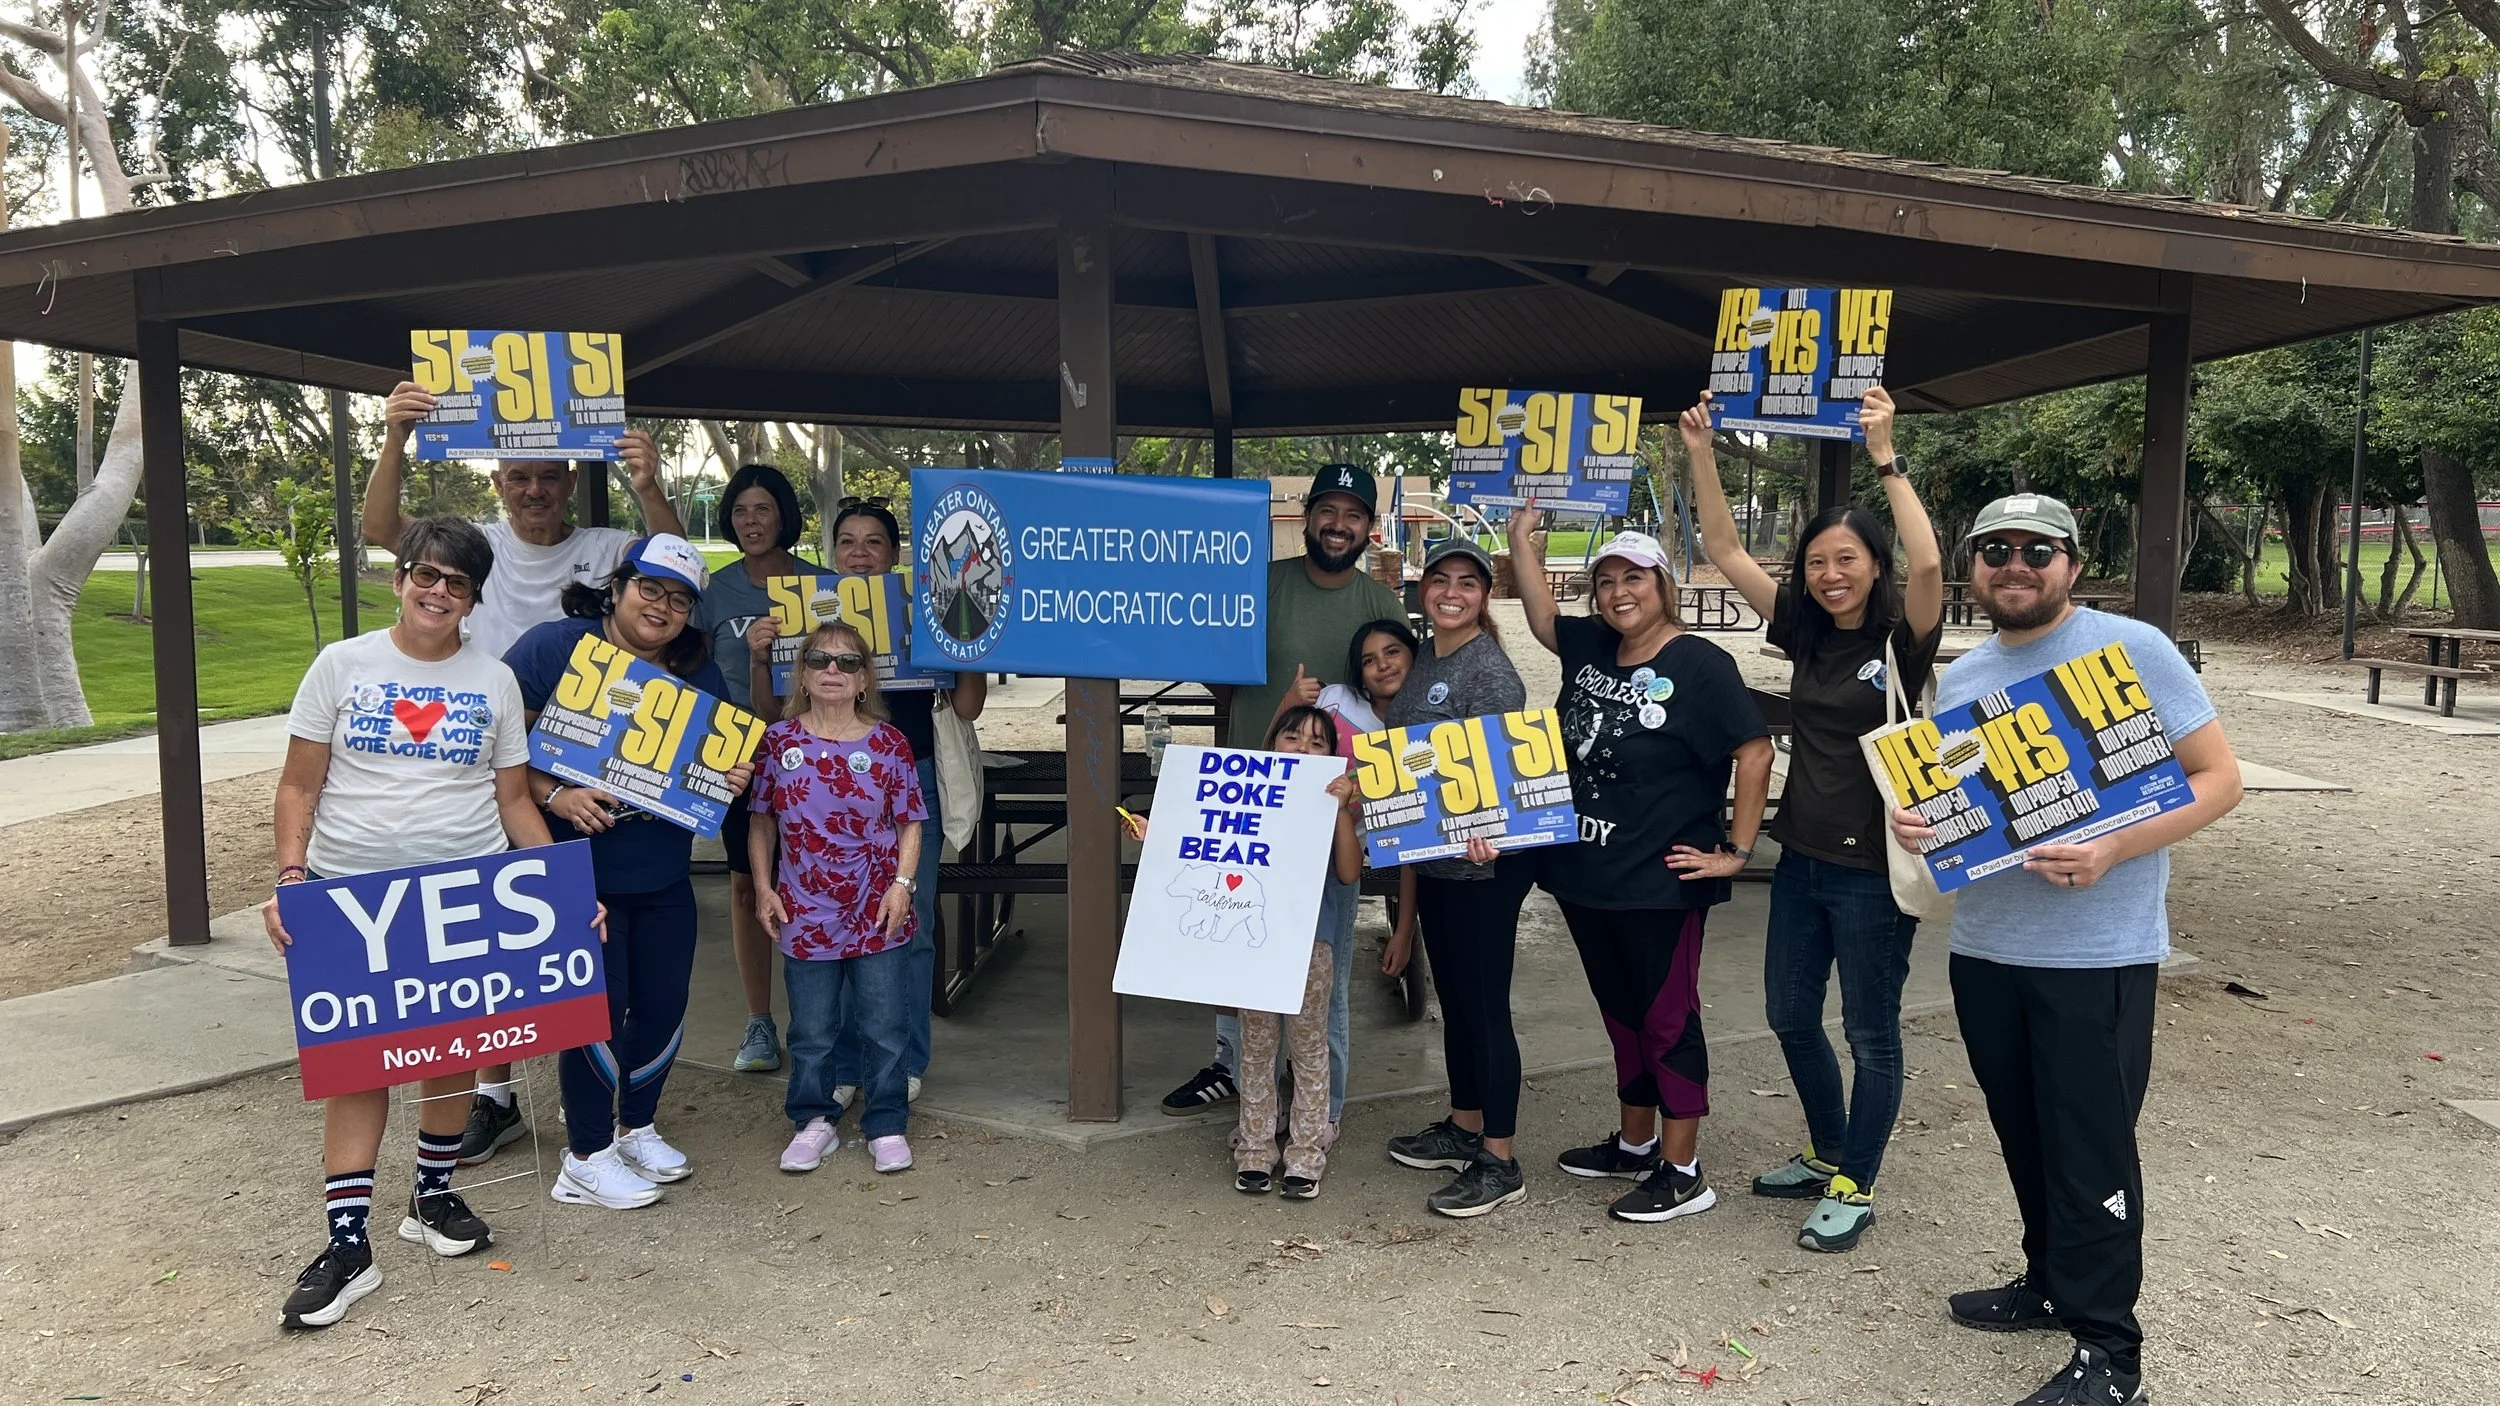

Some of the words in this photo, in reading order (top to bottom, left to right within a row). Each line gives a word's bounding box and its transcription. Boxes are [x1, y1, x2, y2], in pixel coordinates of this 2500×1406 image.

[1788, 289, 1807, 309] VOTE
[1714, 288, 1760, 351] YES
[1839, 289, 1893, 354] YES
[1769, 310, 1820, 373] YES
[1721, 352, 1739, 371] PROP
[1839, 357, 1850, 376] ON
[1852, 356, 1872, 376] PROP
[1769, 374, 1780, 393] ON
[1781, 374, 1800, 394] PROP
[1801, 375, 1812, 394] 50
[438, 407, 478, 421] NOVIEMBRE
[1761, 395, 1803, 416] NOVEMBER
[1803, 396, 1818, 415] 4TH
[424, 433, 436, 441] YES
[507, 419, 550, 435] PROPOSICIÓN
[521, 434, 558, 447] NOVIEMBRE
[1759, 422, 1769, 430] The
[1770, 423, 1797, 432] California
[1798, 425, 1831, 435] Democratic
[1832, 428, 1848, 437] Party
[582, 450, 600, 458] Party
[1338, 467, 1352, 487] LA
[1552, 501, 1586, 509] Democratic
[921, 492, 962, 564] GREATER
[967, 491, 1011, 568] ONTARIO
[1021, 526, 1132, 562] GREATER
[1140, 529, 1250, 565] ONTARIO
[1022, 590, 1182, 624] DEMOCRATIC
[1190, 593, 1255, 627] CLUB
[922, 593, 987, 658] DEMOCRATIC
[990, 594, 1009, 640] CLUB
[401, 686, 445, 702] VOTE
[448, 692, 487, 705] VOTE
[1575, 664, 1652, 710] CHILDLESS
[2053, 640, 2152, 731] YES
[1978, 688, 2015, 718] VOTE
[350, 715, 392, 735] VOTE
[539, 716, 550, 730] EL
[552, 720, 565, 735] DE
[561, 723, 602, 749] NOVIEMBRE
[554, 703, 602, 735] PROPOSICIÓN
[442, 728, 483, 746] VOTE
[538, 741, 551, 751] YES
[1968, 702, 2070, 793] YES
[2096, 727, 2123, 754] ON
[2114, 714, 2154, 746] PROP
[344, 734, 387, 753] VOTE
[390, 742, 436, 759] VOTE
[440, 748, 480, 765] VOTE
[2098, 736, 2172, 781] NOVEMBER
[611, 758, 622, 771] LA
[618, 758, 664, 787] PROPOSICIÓN
[660, 776, 673, 789] 50
[692, 764, 702, 776] LA
[1199, 752, 1299, 780] DON'T
[1876, 720, 1962, 808] YES
[553, 763, 564, 773] Ad
[563, 767, 581, 779] Paid
[579, 773, 589, 782] for
[587, 777, 598, 786] by
[597, 780, 611, 791] The
[611, 786, 643, 803] California
[641, 797, 680, 818] Democratic
[678, 813, 696, 826] Party
[605, 770, 616, 783] EL
[617, 774, 628, 787] DE
[626, 776, 663, 800] NOVIEMBRE
[686, 776, 696, 788] EL
[698, 781, 709, 794] DE
[1196, 780, 1286, 808] POKE
[2008, 789, 2033, 816] ON
[2024, 777, 2064, 808] PROP
[2055, 769, 2080, 795] 50
[2163, 778, 2175, 787] ACT
[1362, 802, 1371, 815] LA
[1370, 792, 1417, 812] PROPOSICIÓN
[1917, 793, 1955, 824] PROP
[1947, 786, 1972, 812] 50
[2010, 797, 2080, 841] NOVEMBER
[2069, 787, 2100, 816] 4TH
[1200, 809, 1261, 836] THE
[1365, 818, 1372, 830] EL
[1378, 815, 1387, 827] DE
[1386, 806, 1426, 825] NOVIEMBRE
[1446, 817, 1455, 829] LA
[1454, 808, 1498, 828] PROPOSICIÓN
[1962, 804, 1992, 833] 4TH
[2082, 811, 2133, 836] Democratic
[2131, 803, 2157, 819] Party
[1179, 836, 1270, 866] BEAR
[1376, 838, 1388, 847] YES
[1391, 837, 1399, 845] 50
[1400, 851, 1410, 859] Ad
[1411, 849, 1426, 857] Paid
[1426, 847, 1435, 855] for
[1436, 846, 1445, 854] by
[1446, 844, 1459, 852] The
[1493, 835, 1532, 846] Democratic
[1533, 832, 1551, 842] Party
[1934, 859, 1950, 871] YES
[1952, 854, 1963, 864] 50
[1968, 867, 1982, 878] Ad
[1981, 859, 2003, 873] Paid
[2000, 854, 2015, 865] for
[2013, 851, 2025, 862] by
[1215, 872, 1221, 889] I
[1197, 889, 1252, 910] California
[327, 859, 555, 973] YES
[301, 992, 377, 1033] On
[395, 972, 524, 1019] Prop.
[539, 949, 594, 993] 50
[383, 1046, 441, 1070] Nov.
[449, 1037, 470, 1058] 4,
[477, 1023, 537, 1052] 2025
[2117, 1190, 2126, 1220] adidas
